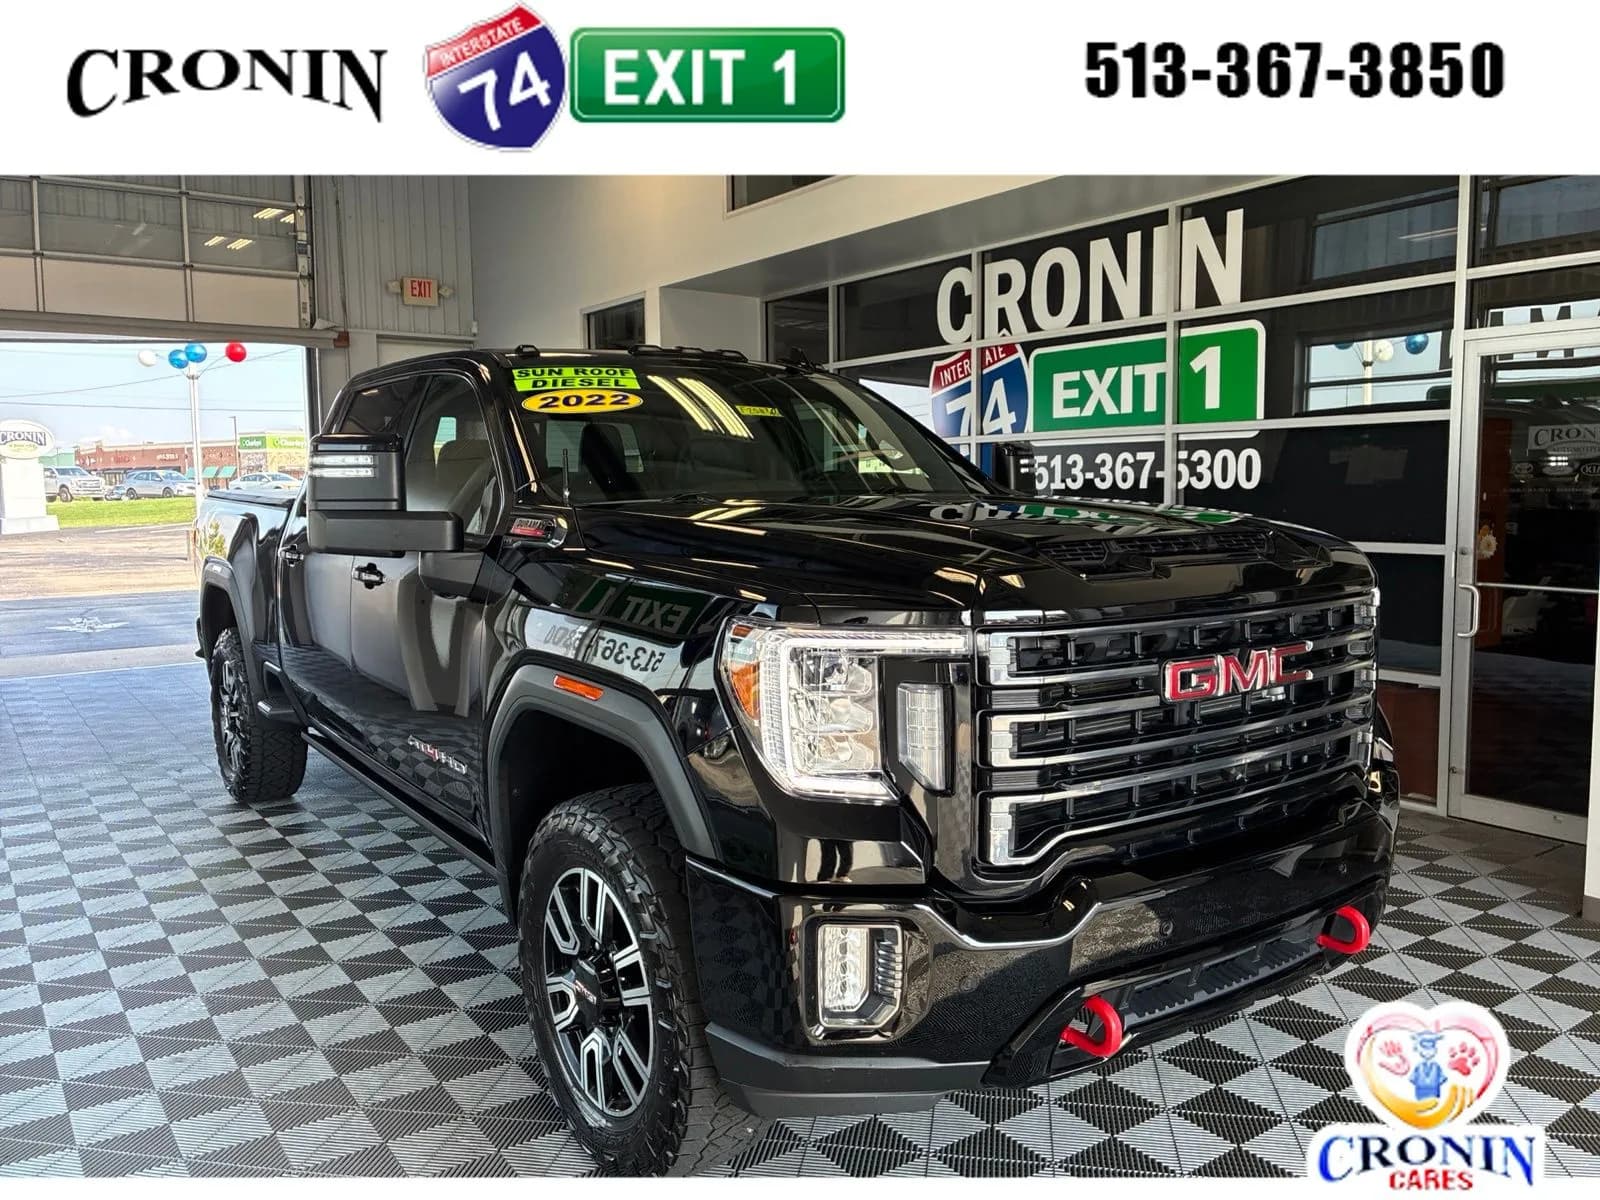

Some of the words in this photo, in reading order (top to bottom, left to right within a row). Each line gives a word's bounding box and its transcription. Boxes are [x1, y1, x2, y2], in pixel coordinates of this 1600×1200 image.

[410, 279, 432, 298] EXIT
[936, 208, 1244, 346] CRONIN
[517, 367, 563, 378] SUN
[573, 367, 632, 378] ROOF
[531, 378, 626, 389] DIESEL
[939, 345, 1007, 387] INTERATE
[1052, 361, 1167, 419] EXIT
[1189, 345, 1221, 410] 1
[538, 394, 630, 409] 2022
[945, 378, 1017, 456] 74
[0, 430, 47, 446] CRONIN
[1034, 448, 1262, 490] 513-367-5300
[1164, 640, 1314, 702] GMC
